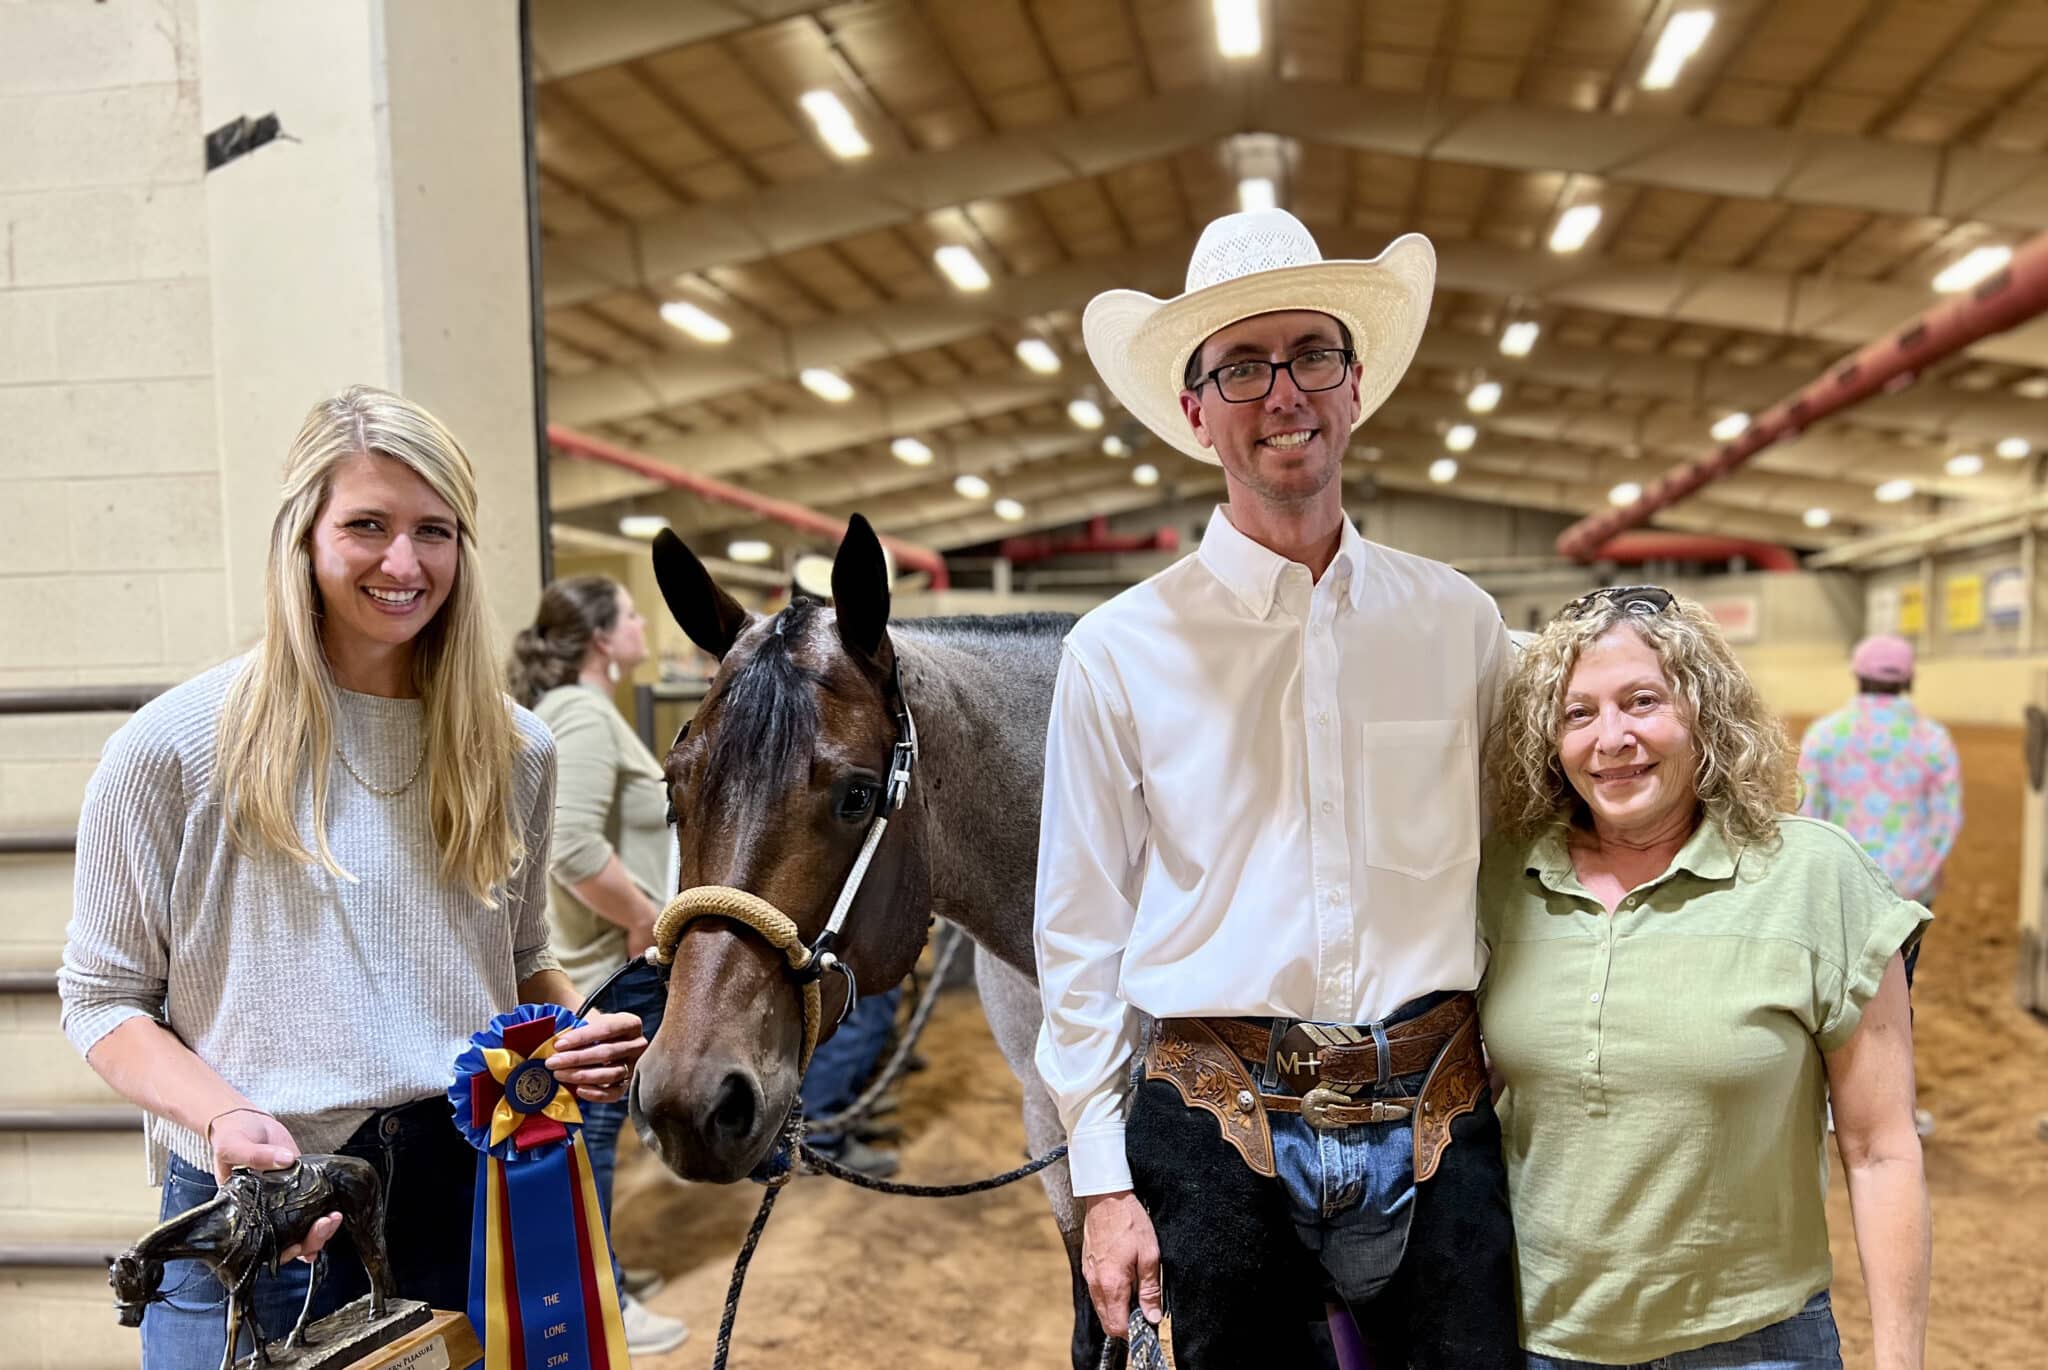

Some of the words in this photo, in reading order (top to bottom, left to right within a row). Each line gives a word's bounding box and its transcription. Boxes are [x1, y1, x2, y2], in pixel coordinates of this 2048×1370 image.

[543, 1292, 560, 1307] THE
[544, 1322, 567, 1339] LONE
[403, 1343, 433, 1366] PLEASURE
[547, 1352, 569, 1368] STAR
